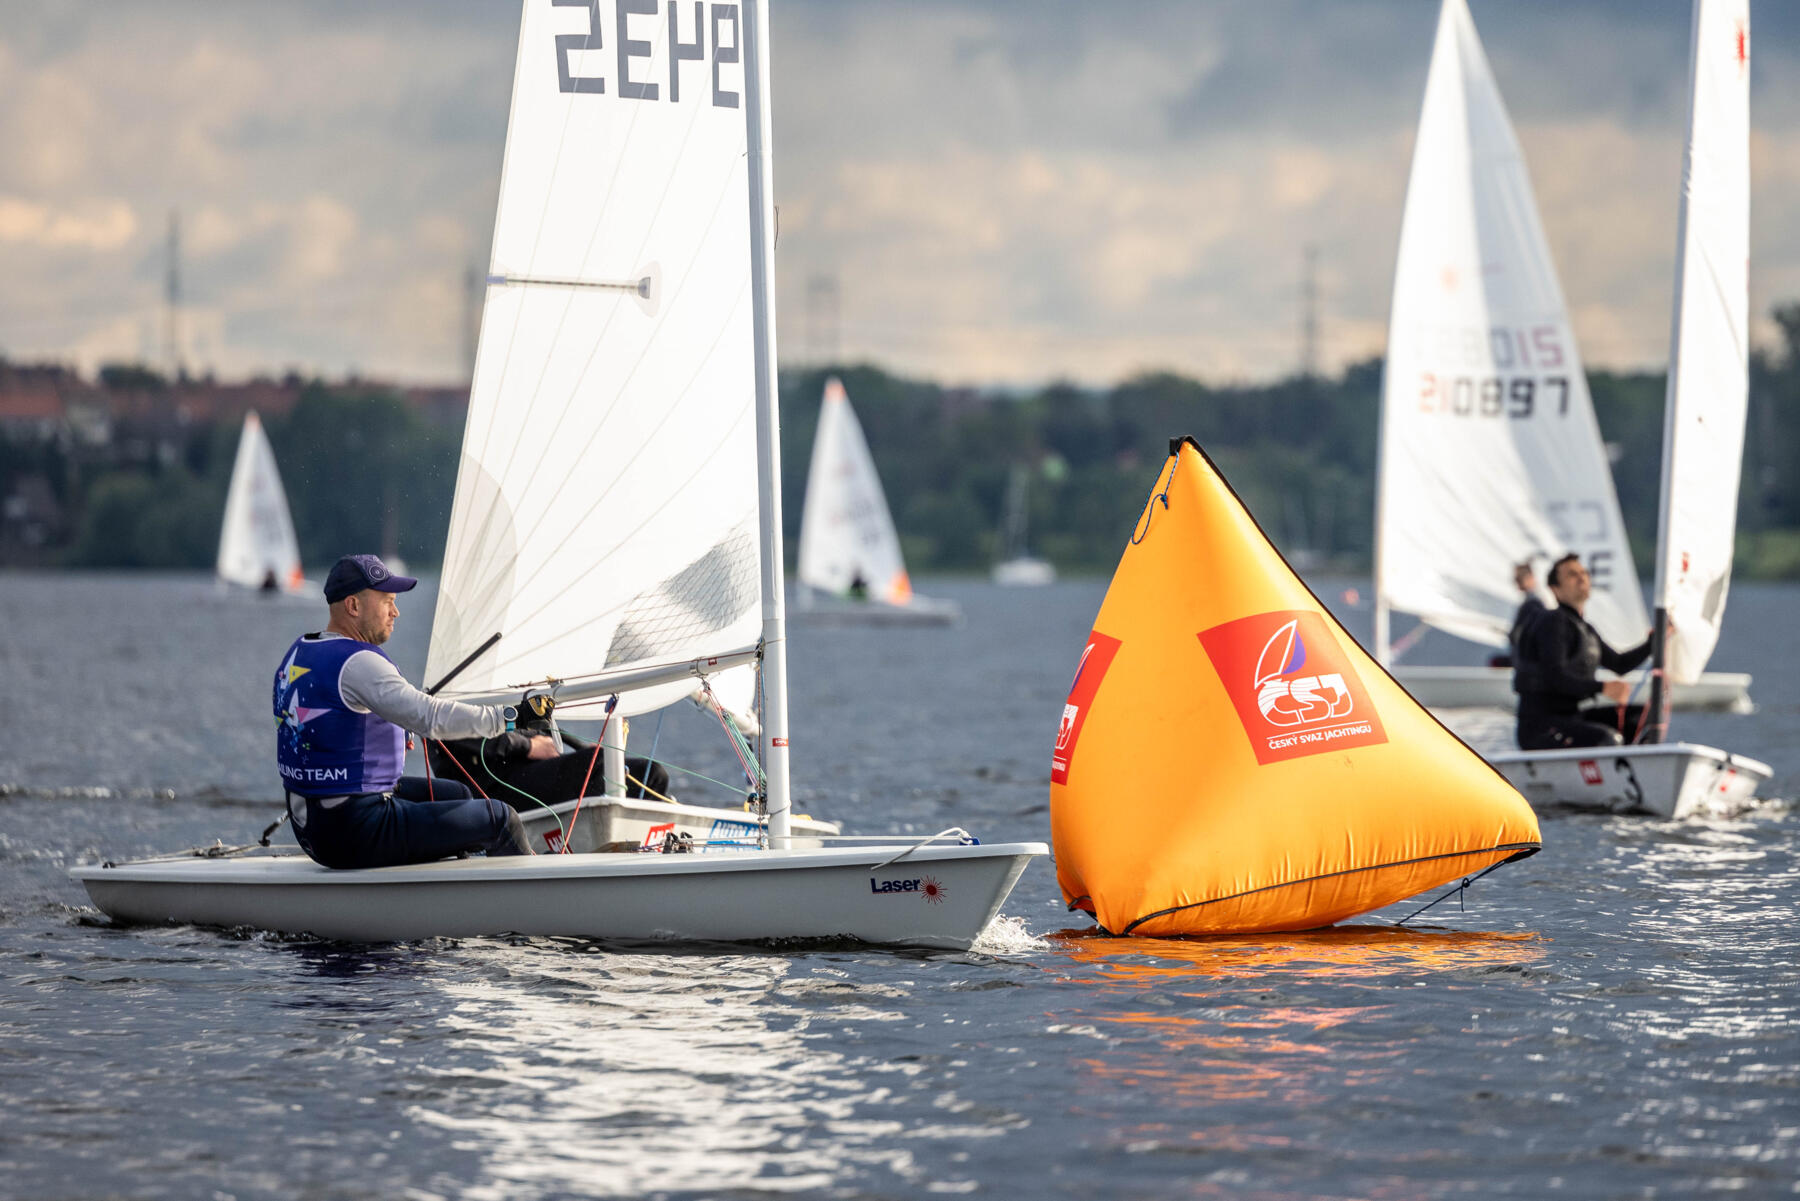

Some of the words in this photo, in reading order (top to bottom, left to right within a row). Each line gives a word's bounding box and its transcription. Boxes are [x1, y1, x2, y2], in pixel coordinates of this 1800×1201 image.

[1299, 732, 1324, 744] SVAZ
[1324, 725, 1372, 741] JACHTINGU
[304, 768, 348, 781] TEAM
[870, 878, 921, 893] Laser
